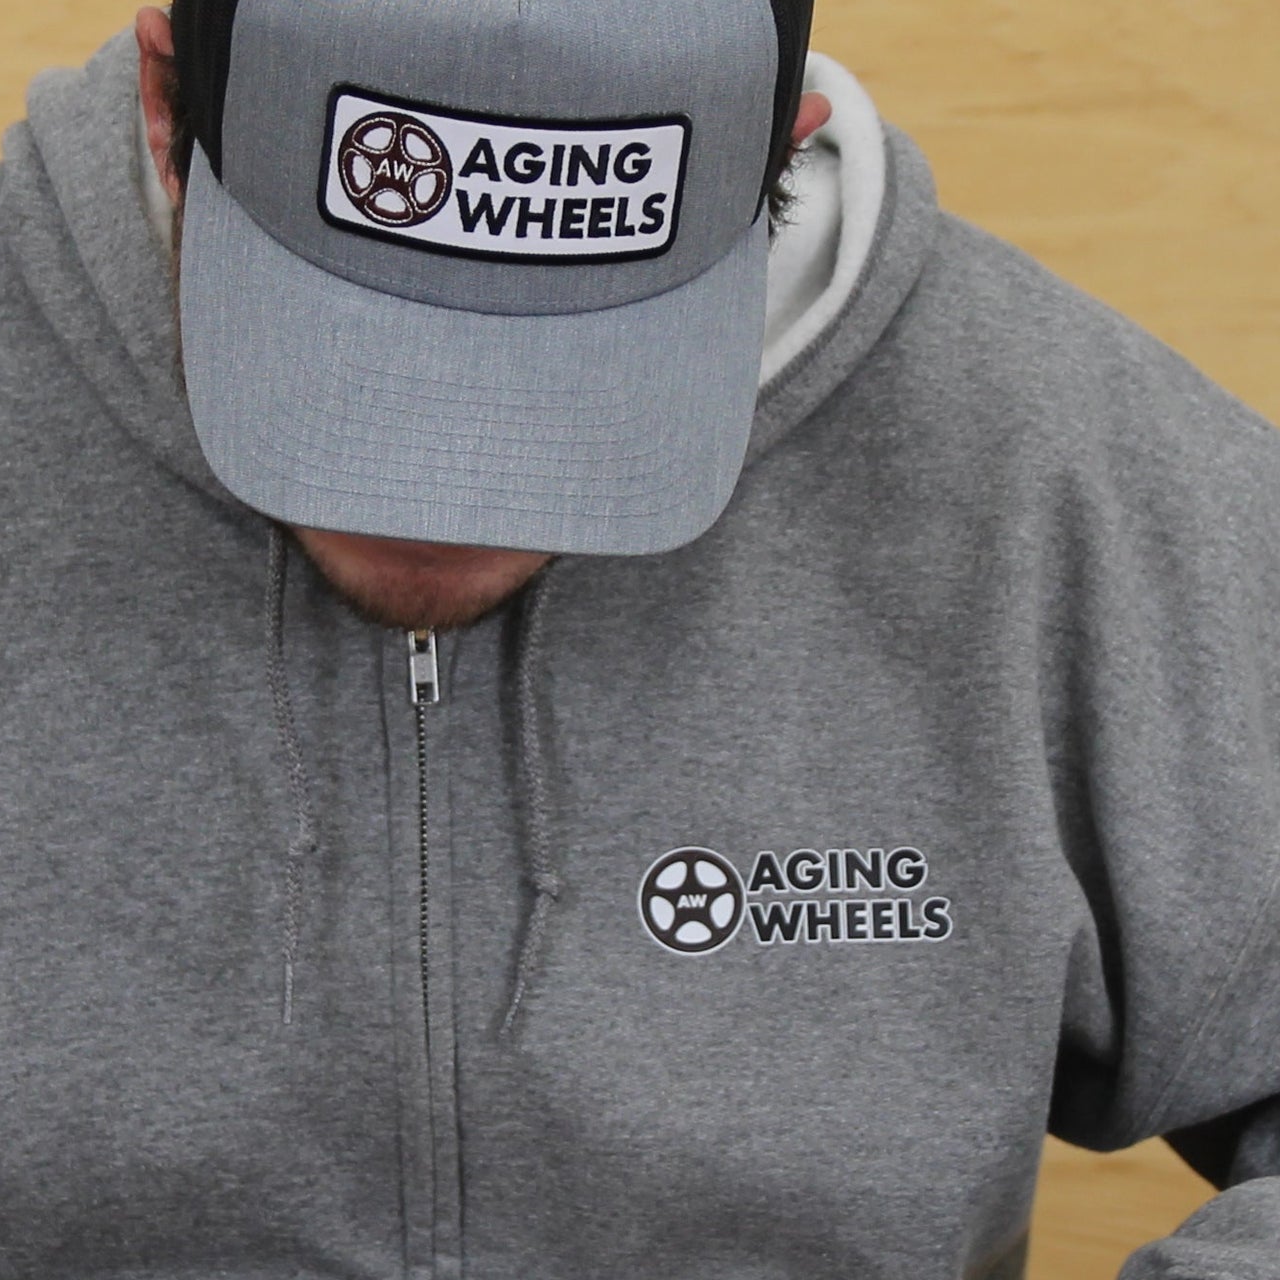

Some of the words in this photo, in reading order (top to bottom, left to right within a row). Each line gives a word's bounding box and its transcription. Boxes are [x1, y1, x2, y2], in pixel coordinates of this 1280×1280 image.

[375, 157, 415, 182] AW
[458, 137, 653, 187] AGING
[455, 188, 667, 240] WHEELS
[748, 847, 929, 893] AGING
[676, 894, 708, 909] AW
[748, 897, 953, 944] WHEELS
